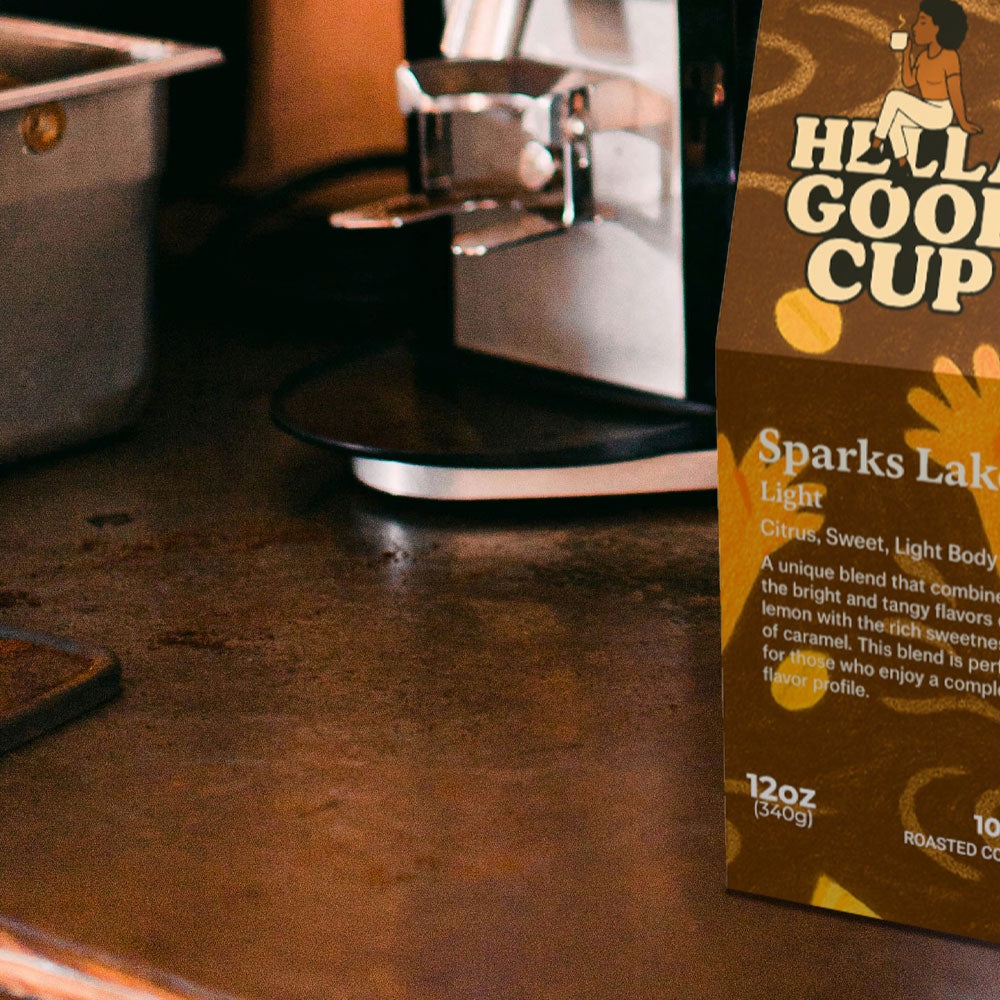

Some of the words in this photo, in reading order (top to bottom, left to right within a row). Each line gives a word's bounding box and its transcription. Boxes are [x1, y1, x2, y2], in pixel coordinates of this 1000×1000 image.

[805, 237, 996, 314] CUP
[759, 428, 905, 479] Sparks
[760, 481, 823, 511] Light
[760, 519, 821, 545] Citrus,
[826, 527, 889, 555] Sweet,
[895, 537, 942, 562] Light
[949, 545, 997, 571] Body
[761, 556, 774, 571] A
[778, 560, 835, 580] unique
[840, 566, 886, 588] blend
[892, 575, 925, 593] that
[761, 579, 787, 595] the
[793, 583, 841, 605] bright
[847, 592, 877, 609] and
[883, 598, 930, 620] tangy
[935, 603, 993, 626] flavors
[762, 601, 812, 621] lemon
[818, 610, 852, 628] with
[858, 615, 884, 632] the
[889, 620, 921, 639] rich
[762, 624, 778, 638] of
[784, 628, 852, 650] caramel.
[858, 637, 892, 657] This
[897, 644, 945, 665] blend
[950, 653, 963, 667] is
[763, 646, 785, 661] for
[790, 650, 835, 670] those
[840, 658, 874, 676] who
[879, 666, 924, 688] enjoy
[929, 674, 939, 687] a
[763, 667, 807, 686] flavor
[813, 676, 870, 698] profile.
[746, 773, 816, 809] 12oz
[754, 800, 813, 829] (340g)
[904, 831, 977, 857] ROASTED
